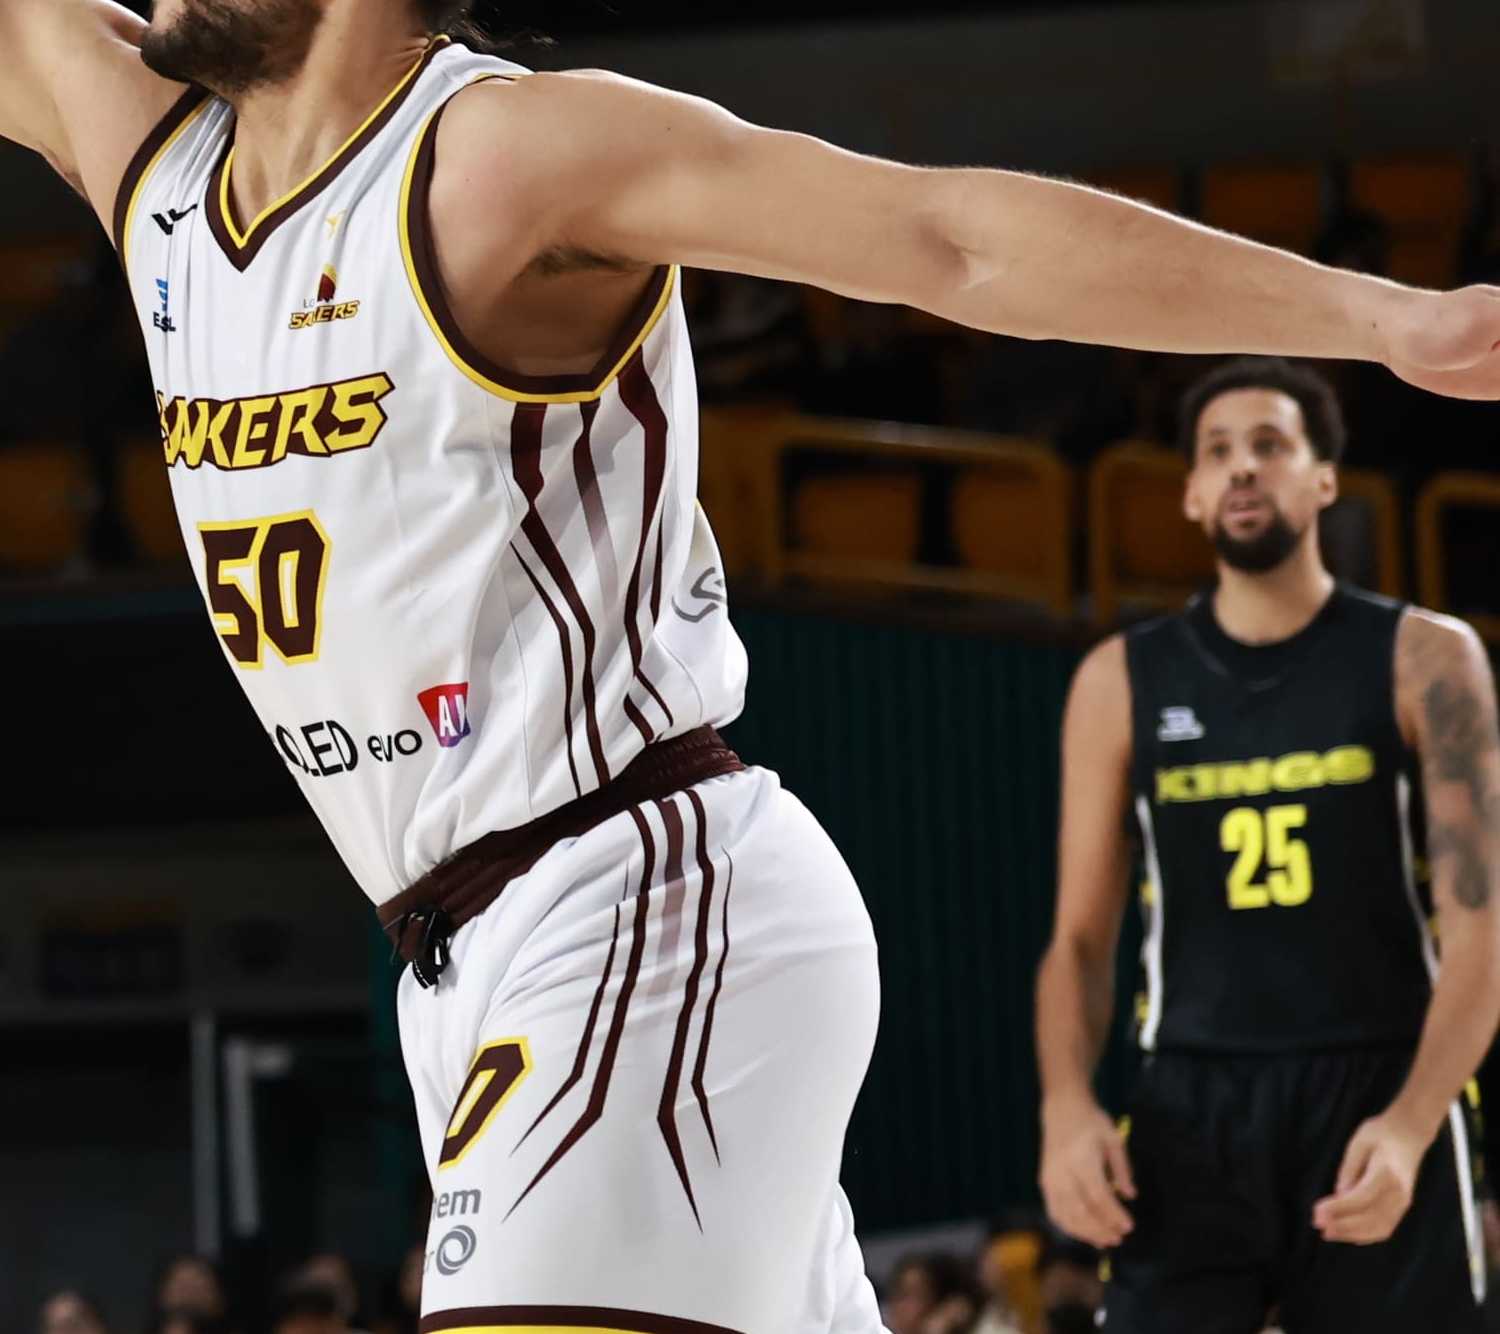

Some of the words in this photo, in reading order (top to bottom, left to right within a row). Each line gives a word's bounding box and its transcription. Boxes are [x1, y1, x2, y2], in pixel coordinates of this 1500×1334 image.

[289, 300, 360, 330] SAERS
[196, 509, 331, 670] 50
[367, 729, 423, 763] evo
[1156, 745, 1374, 805] KINGS
[1220, 803, 1314, 910] 25
